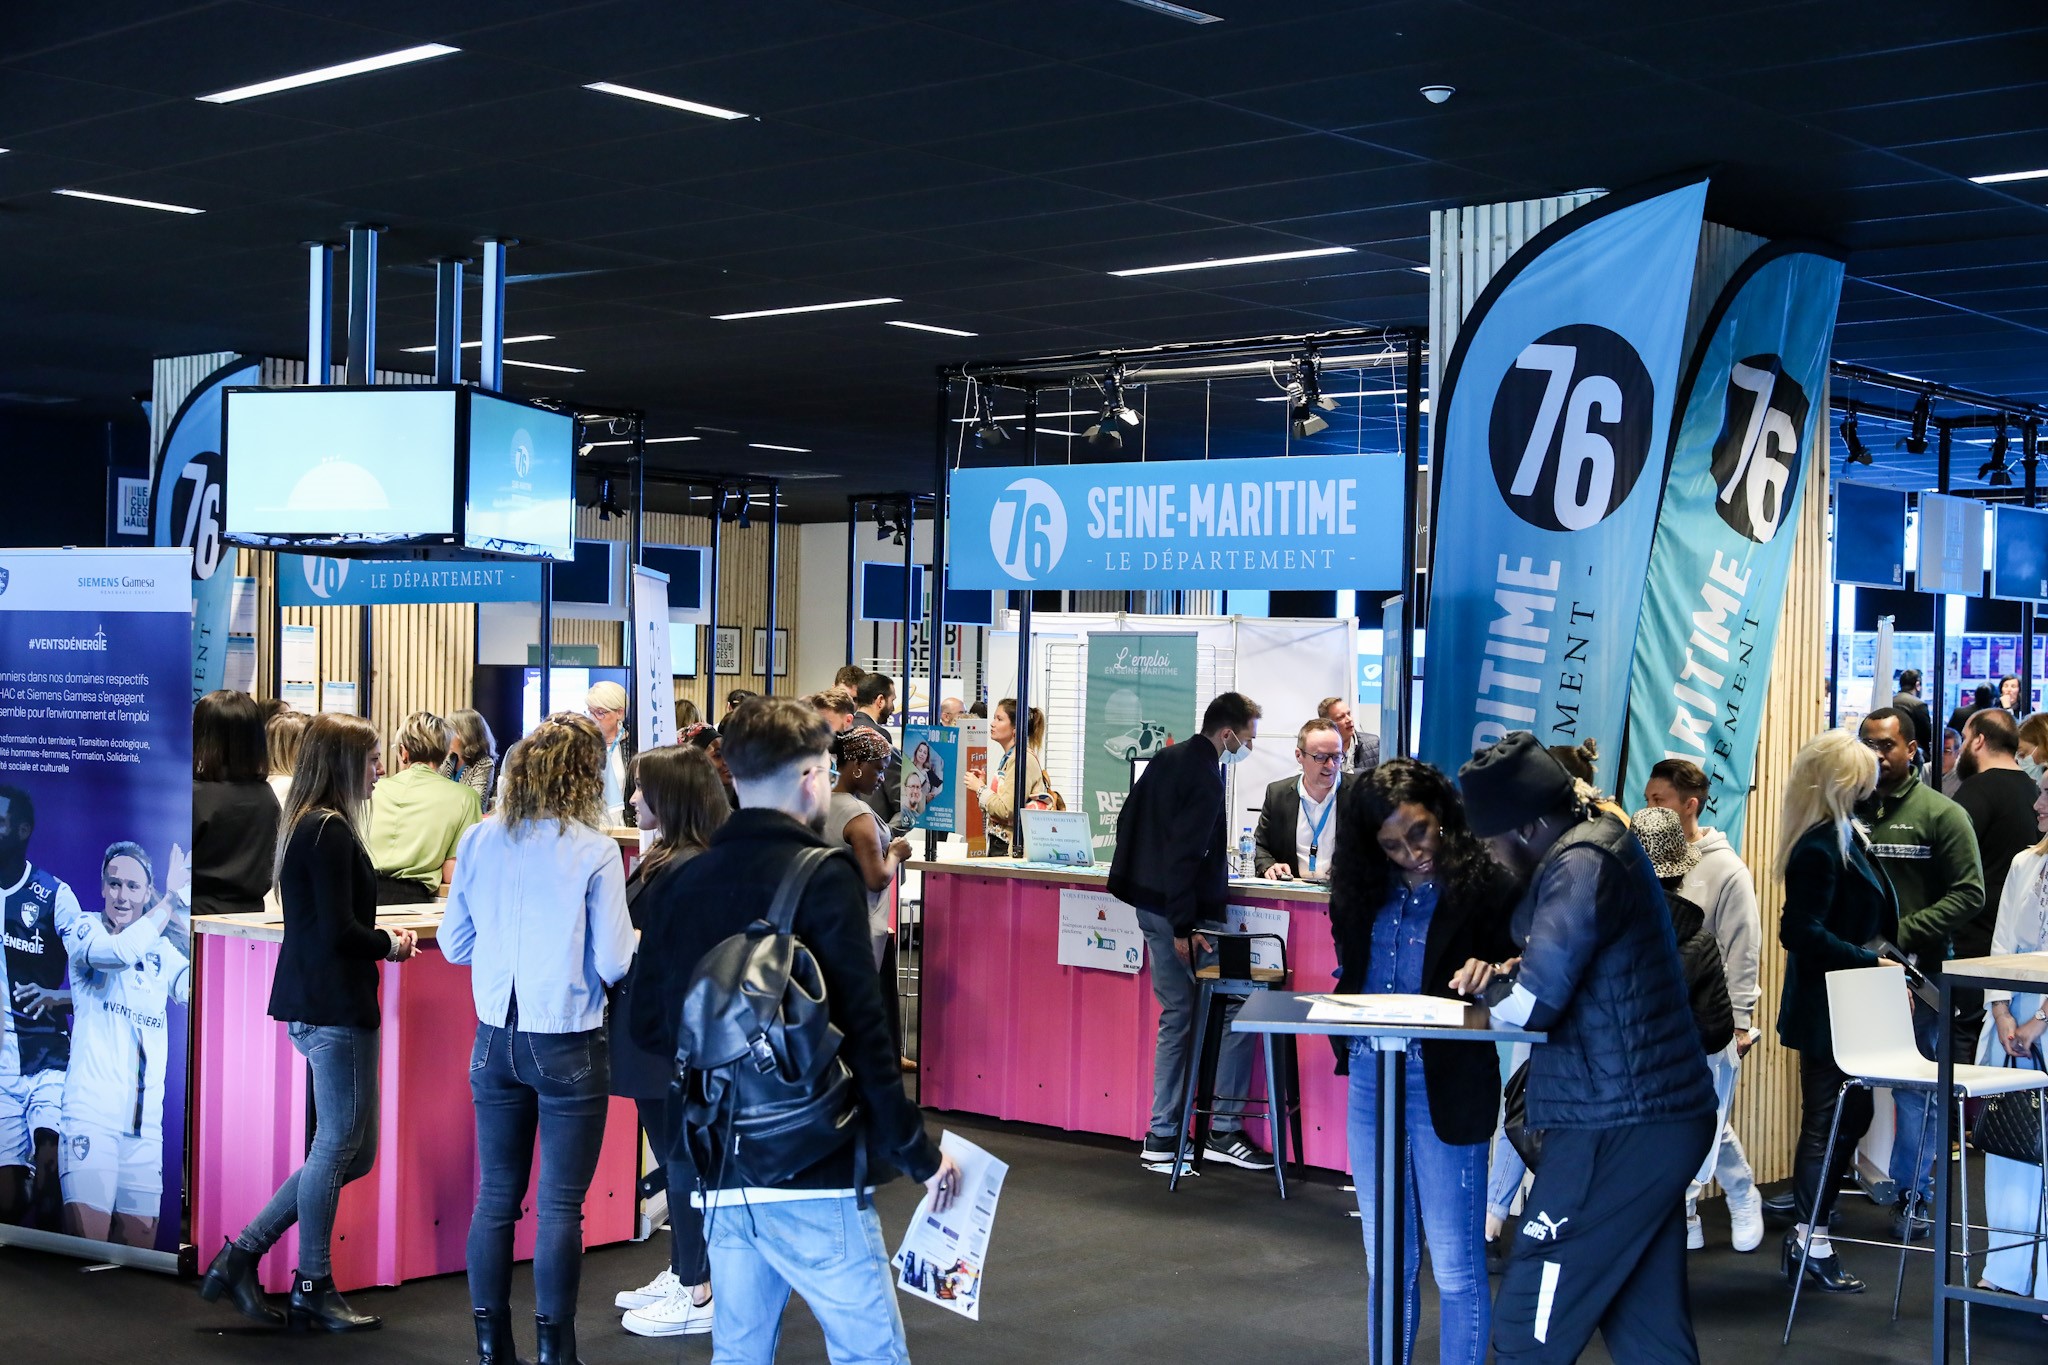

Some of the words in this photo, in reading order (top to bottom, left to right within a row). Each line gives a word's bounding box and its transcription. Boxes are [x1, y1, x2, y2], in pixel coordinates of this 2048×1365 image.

[1510, 343, 1623, 530] 76
[1720, 362, 1798, 544] 76
[181, 462, 221, 580] 76
[999, 489, 1051, 577] 76
[1087, 479, 1357, 539] SEINE-MARITIME
[1105, 551, 1132, 571] LE
[1143, 547, 1336, 571] DÉPARTEMENT
[78, 577, 119, 588] SIEMENS
[121, 576, 155, 588] Gamesa
[371, 573, 388, 589] LE
[393, 569, 504, 588] DÉPARTEMENT
[29, 631, 107, 651] #VENTSDÉNERGIE
[716, 659, 735, 668] ALLES
[1113, 646, 1171, 671] L'emploi
[27, 671, 48, 683] dans
[49, 673, 64, 684] nos
[65, 672, 105, 685] domaines
[105, 673, 149, 687] respectifs
[1104, 666, 1115, 675] EN
[1116, 667, 1179, 676] SEINE-MARITIME
[1552, 601, 1596, 738] MENT
[17, 690, 26, 700] et
[27, 688, 62, 701] Siemens
[63, 689, 97, 702] Gamesa
[98, 691, 145, 706] s'engagent
[0, 706, 27, 718] semble
[27, 709, 46, 720] pour
[46, 707, 107, 721] l'environnement
[108, 711, 117, 721] et
[117, 710, 150, 724] l'emploi
[38, 735, 47, 745] du
[48, 736, 78, 747] territoire,
[78, 736, 110, 748] Transition
[110, 738, 151, 751] écologique,
[10, 748, 71, 761] hommes-femmes,
[71, 750, 106, 762] Formation,
[106, 751, 141, 763] Solidarité,
[8, 761, 31, 772] sociale
[32, 763, 39, 772] et
[39, 763, 70, 774] culturelle
